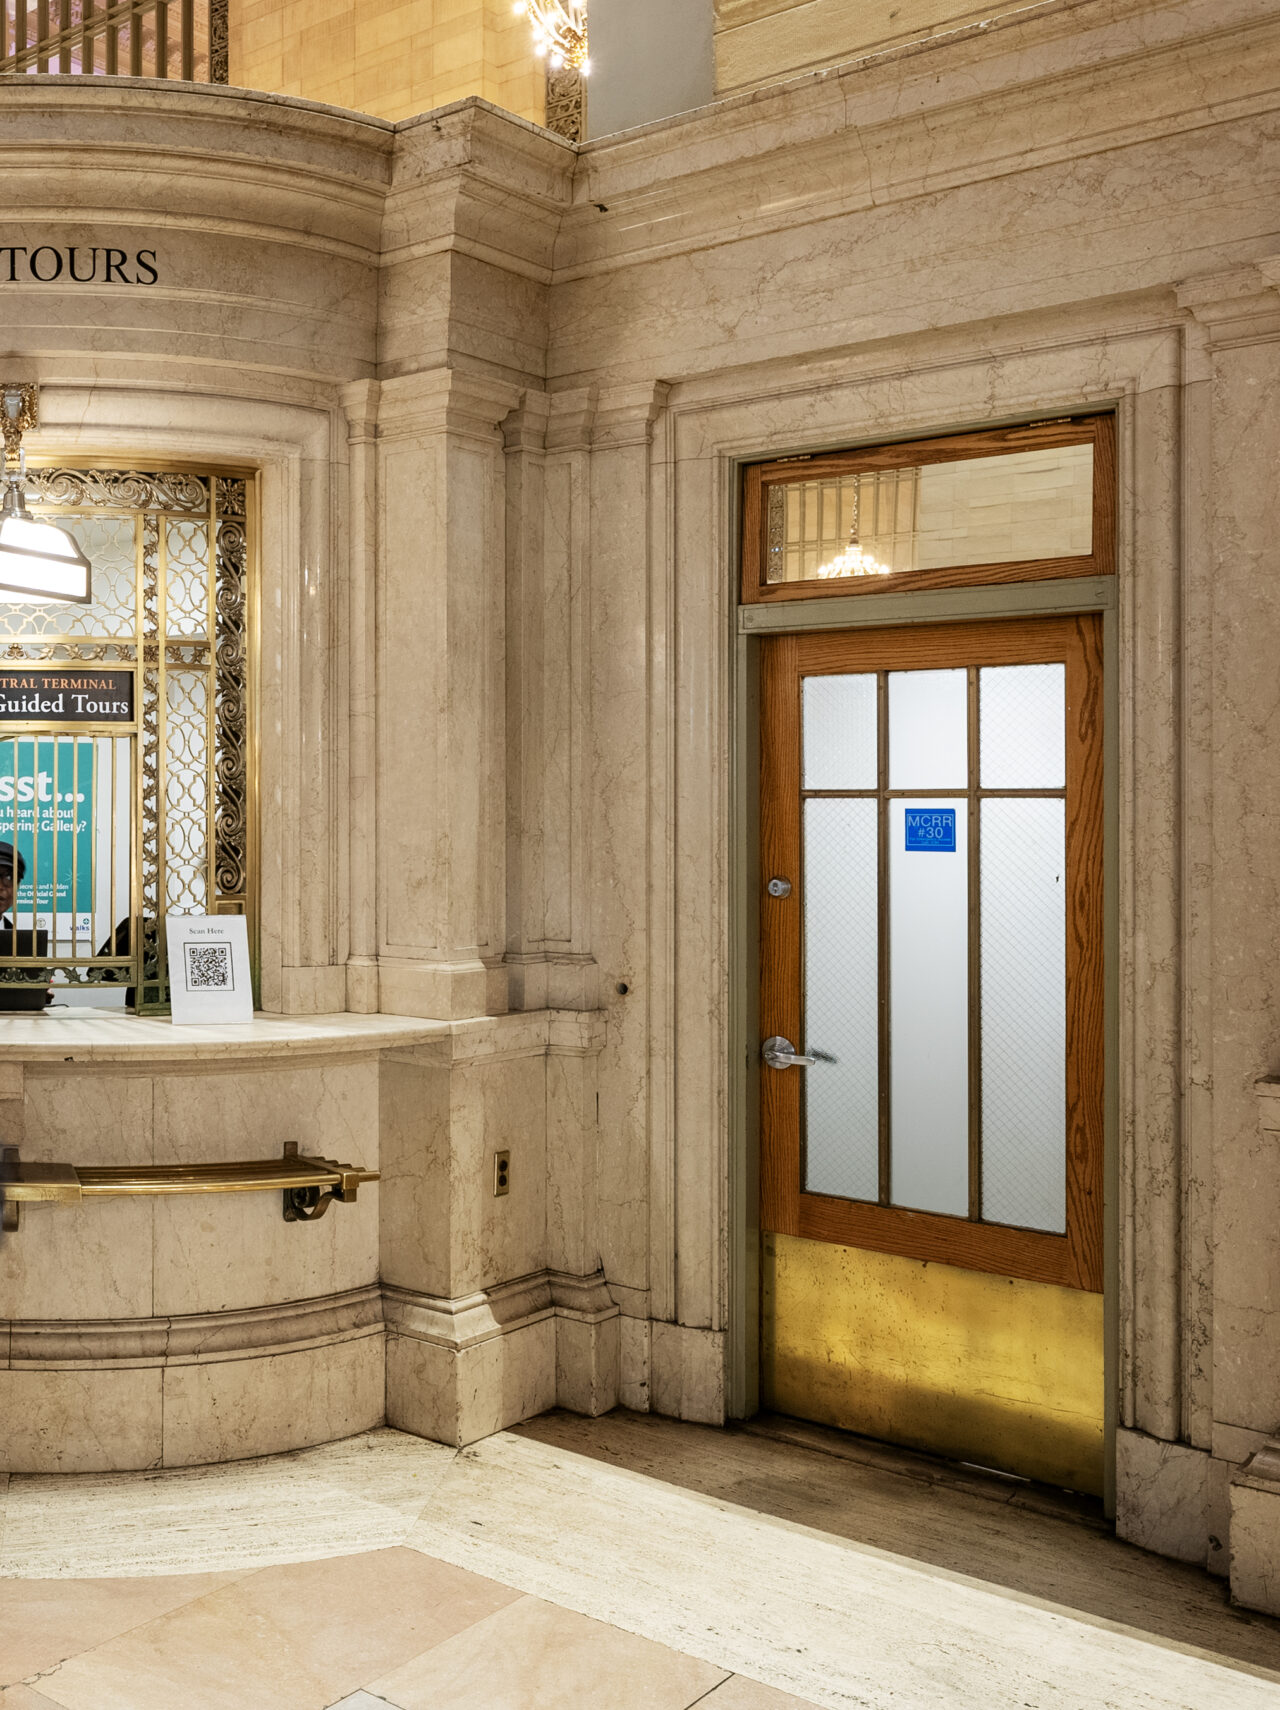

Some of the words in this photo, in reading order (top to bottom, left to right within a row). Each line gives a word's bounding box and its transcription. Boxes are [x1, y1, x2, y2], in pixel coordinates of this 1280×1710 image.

[42, 678, 116, 690] TERMINAL
[72, 694, 128, 714] Tours
[42, 806, 74, 818] about
[908, 816, 952, 827] MCRR
[918, 827, 943, 838] #30
